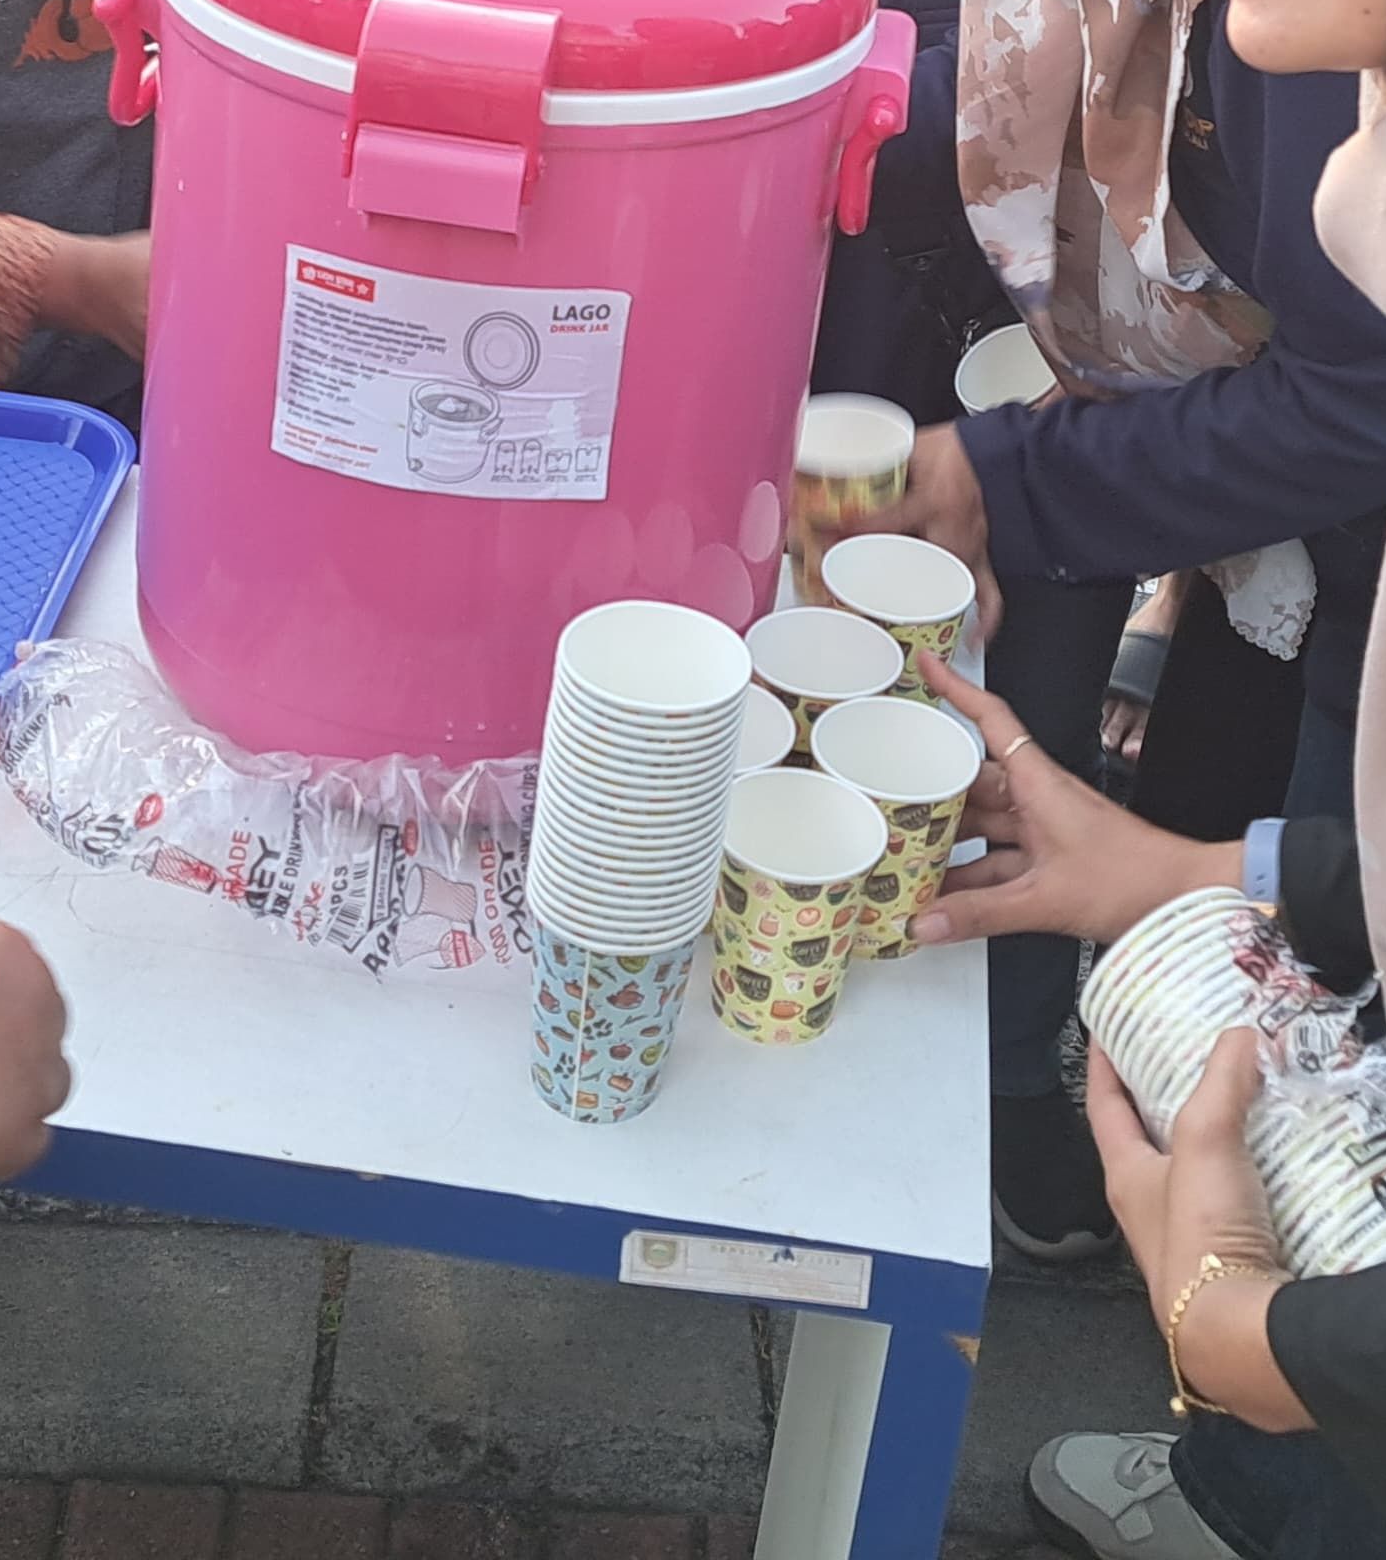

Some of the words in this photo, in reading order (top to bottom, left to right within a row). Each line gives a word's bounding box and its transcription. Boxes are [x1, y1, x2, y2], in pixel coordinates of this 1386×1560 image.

[552, 303, 612, 322] LAGO
[549, 323, 587, 334] DRINK
[587, 323, 610, 333] JAR
[223, 829, 252, 900] RADE
